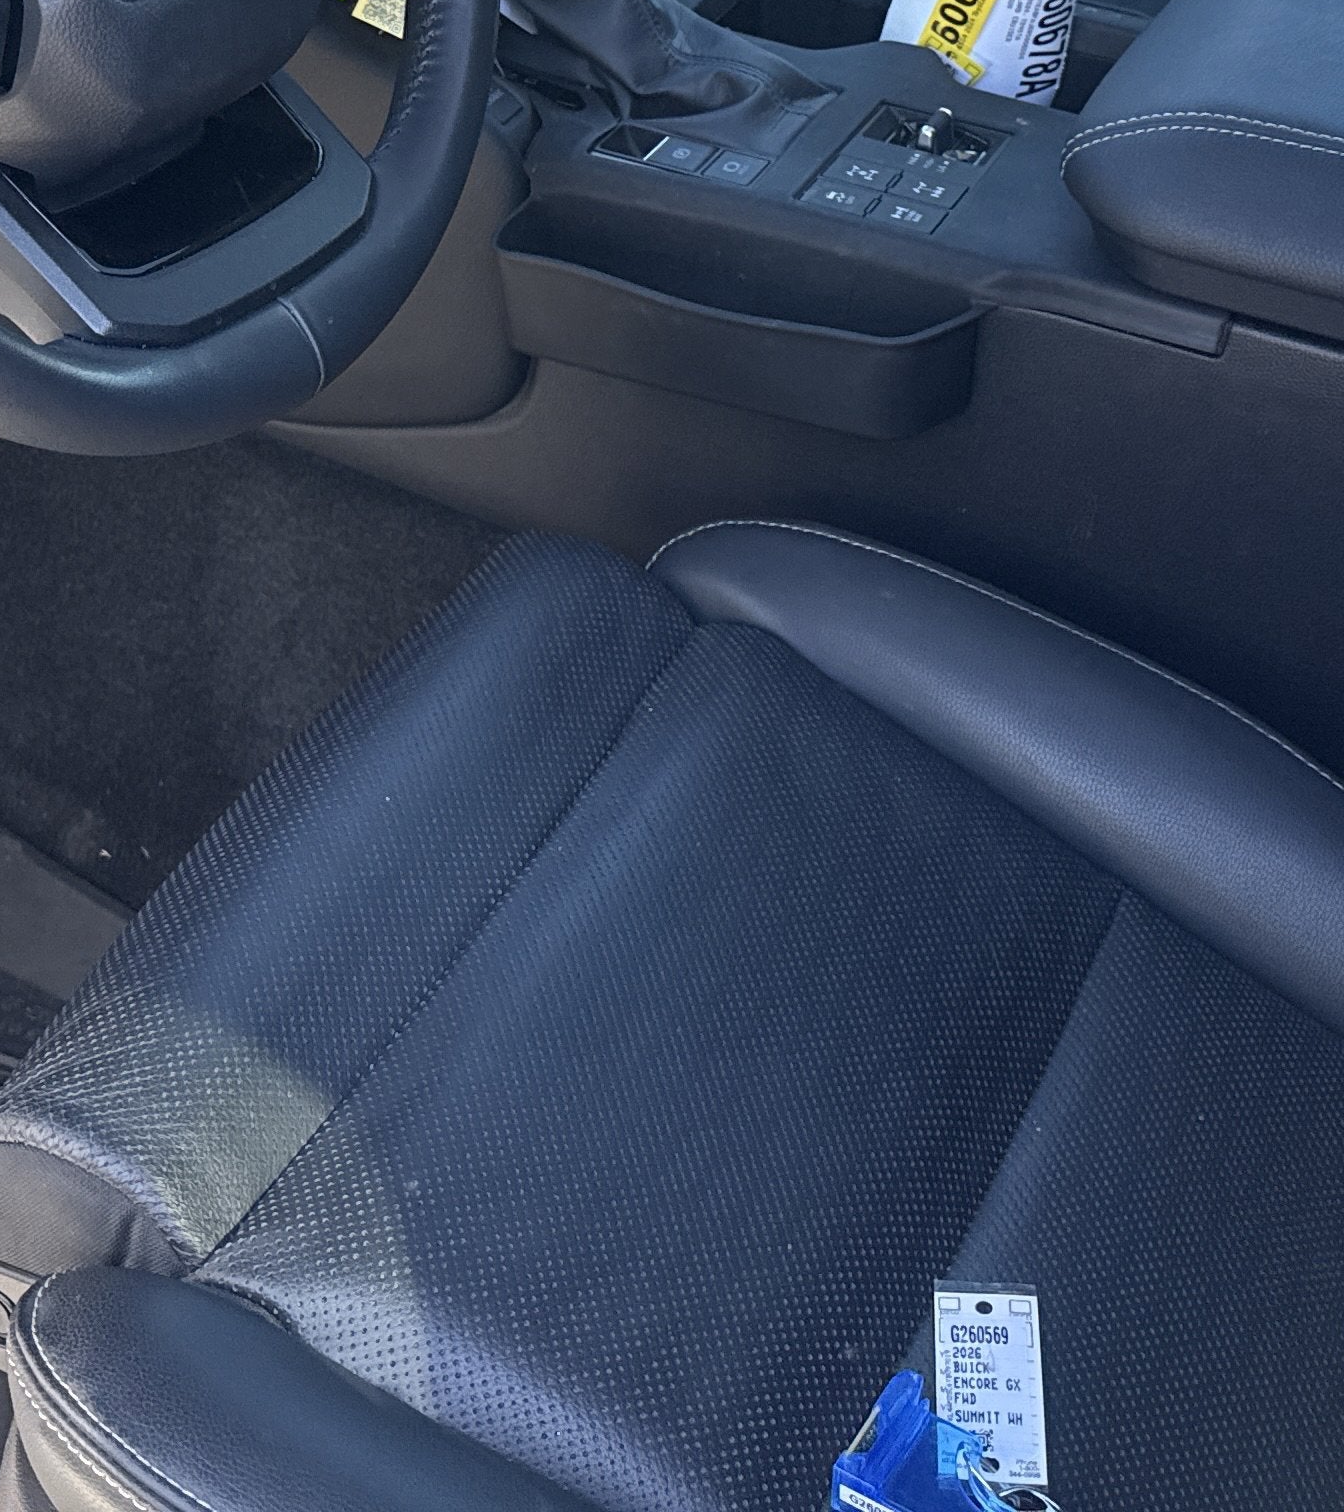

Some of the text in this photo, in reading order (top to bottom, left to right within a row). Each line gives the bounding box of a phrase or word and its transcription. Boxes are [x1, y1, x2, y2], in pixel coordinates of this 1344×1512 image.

[950, 1325, 1009, 1345] G260569
[952, 1347, 982, 1359] 2026
[953, 1361, 990, 1374] BUICK
[954, 1376, 1022, 1391] ENCORE GX
[954, 1392, 976, 1405] FWD
[955, 1409, 1023, 1426] SUMMIT WH
